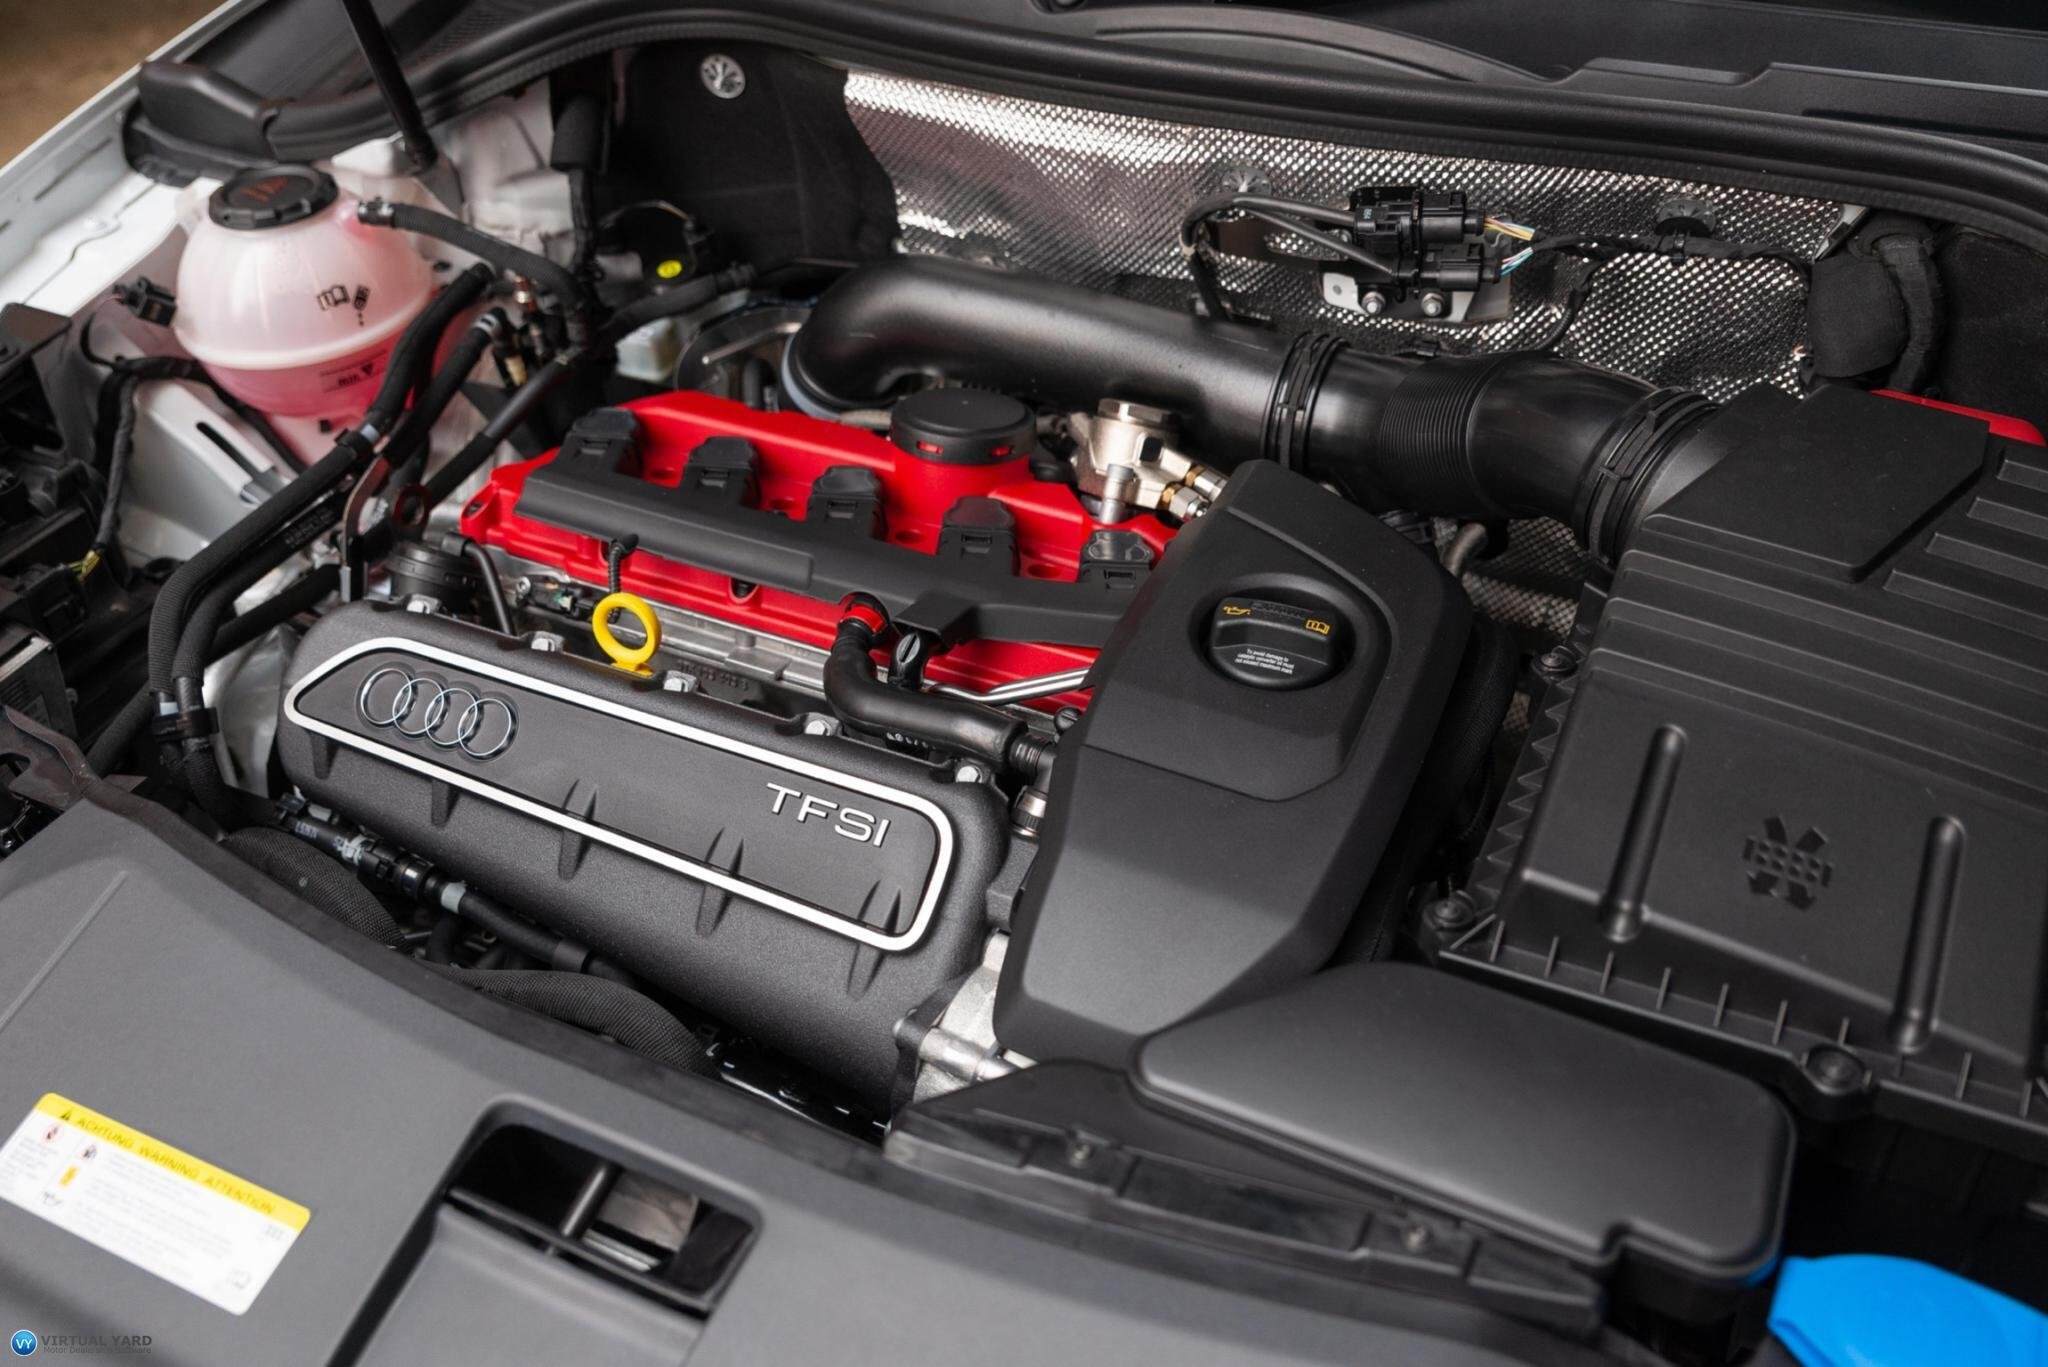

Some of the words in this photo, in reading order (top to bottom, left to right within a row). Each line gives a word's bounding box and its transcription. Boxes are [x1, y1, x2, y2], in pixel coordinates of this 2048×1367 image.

[1265, 653, 1284, 661] damage
[766, 782, 891, 848] TFSI
[77, 1118, 135, 1149] ACHTUNG
[139, 1145, 199, 1180] WARNING
[205, 1176, 273, 1214] ATTENTION
